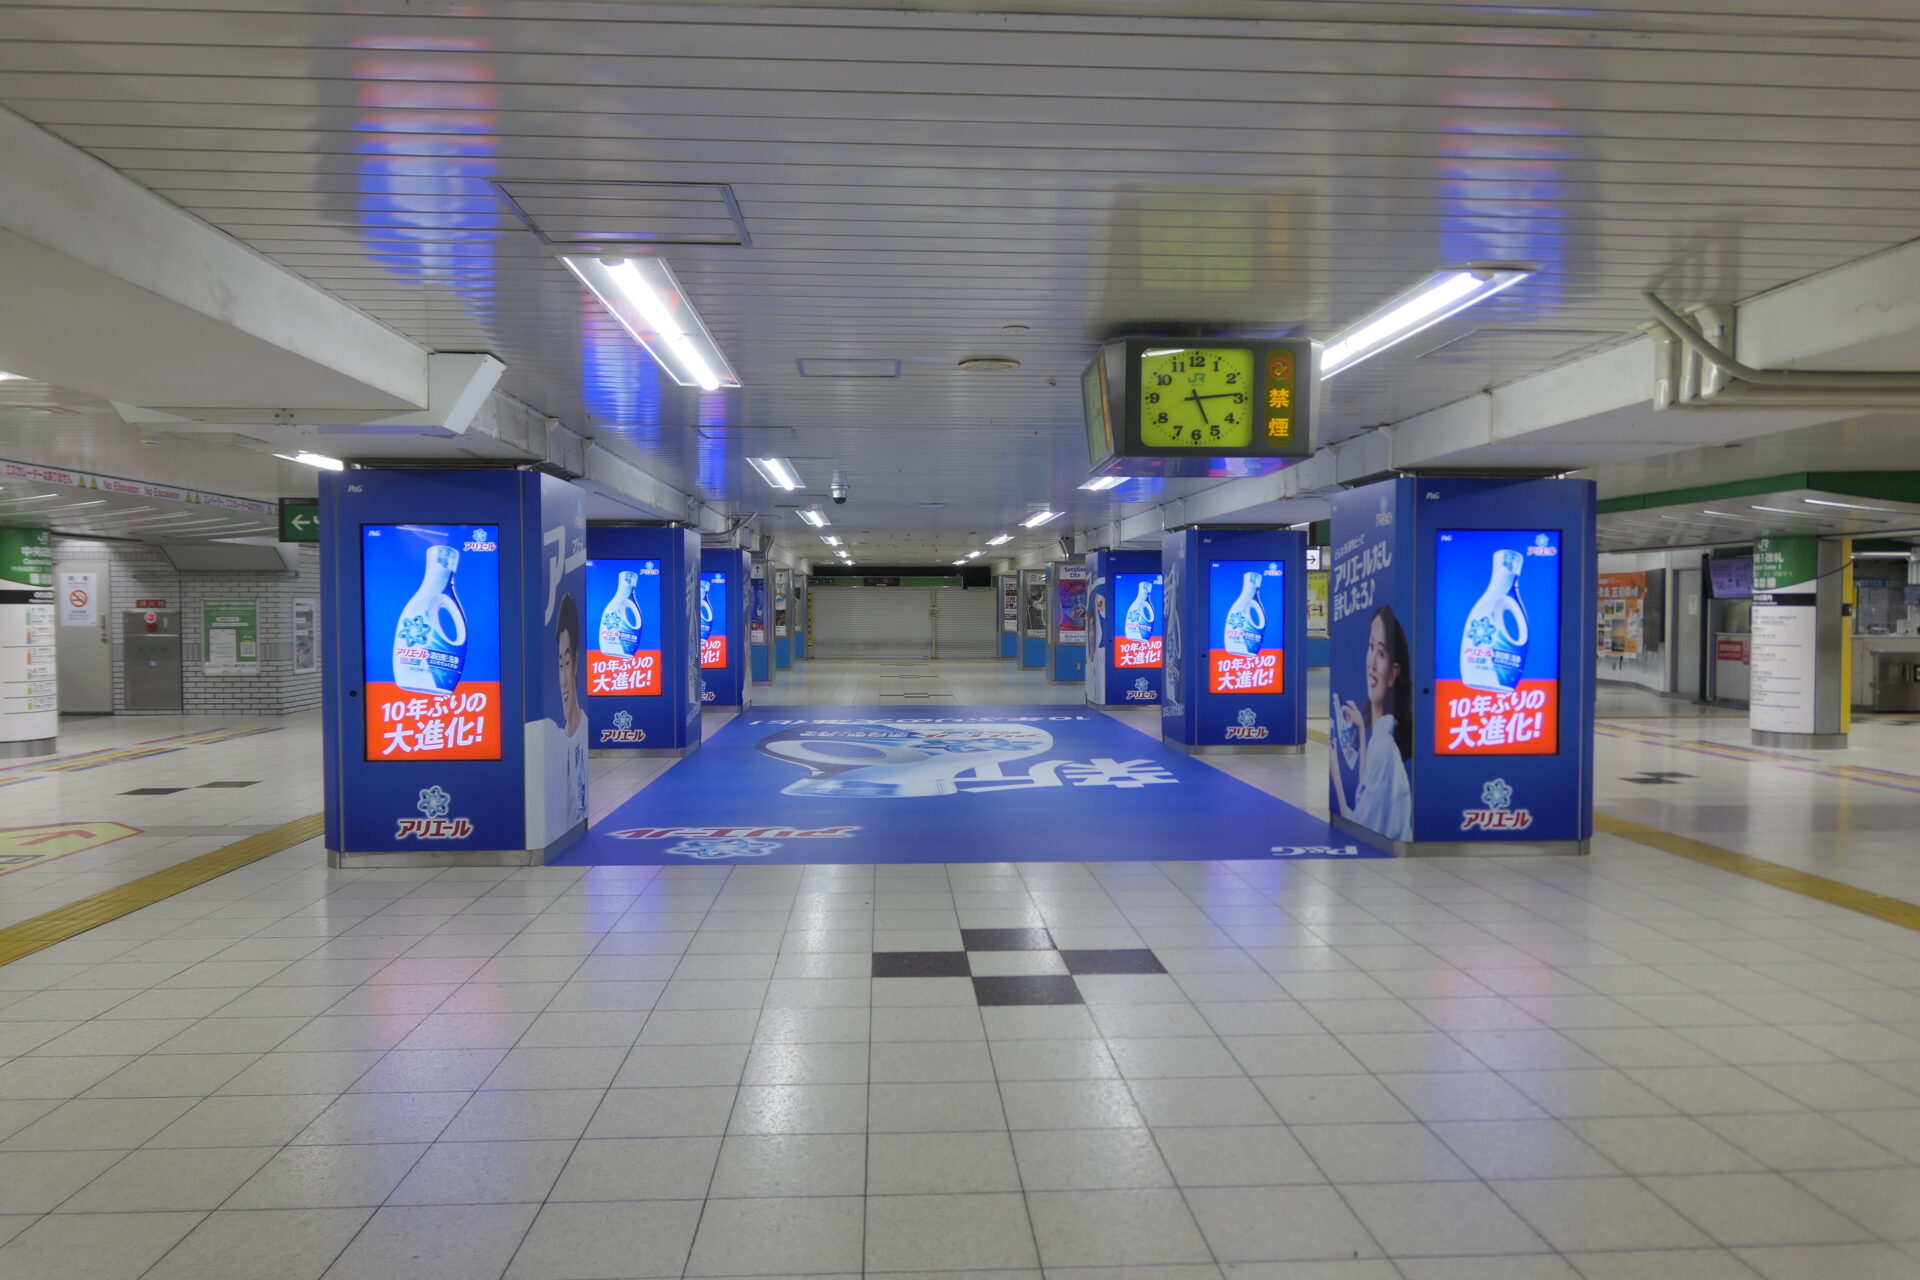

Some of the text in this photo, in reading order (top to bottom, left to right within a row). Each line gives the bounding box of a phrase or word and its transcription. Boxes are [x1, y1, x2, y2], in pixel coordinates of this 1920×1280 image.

[1172, 361, 1185, 372] 11
[1189, 356, 1205, 367] 12
[1213, 361, 1219, 371] 1
[1157, 374, 1172, 386] 10
[1188, 373, 1205, 383] JR
[1226, 373, 1237, 384] 2
[1149, 392, 1160, 404] 9
[1233, 393, 1244, 404] 3
[1157, 412, 1168, 424] 8
[1224, 413, 1235, 424] 4
[1269, 388, 1289, 437] 禁煙
[1173, 425, 1184, 437] 7
[1191, 429, 1201, 441] 6
[1210, 425, 1220, 436] 5
[103, 480, 180, 500] No Elevator No Escalator
[1426, 491, 1440, 500] P&G
[463, 542, 496, 552] アリエール
[1526, 546, 1558, 556] アリエール
[396, 648, 428, 659] アリエール
[1120, 650, 1162, 667] 大進化!
[592, 656, 654, 674] 10年ぶりの
[1217, 655, 1276, 672] 10年ぶりの
[592, 669, 652, 693] 大進化!
[1217, 668, 1275, 691] 大進化!
[1126, 691, 1157, 700] アリエール
[381, 692, 487, 722] 10年ぶりの
[1448, 689, 1546, 719] 10年ぶりの
[382, 715, 485, 756] 大進化!
[601, 729, 646, 742] アリエール
[1225, 726, 1269, 739] アリエール
[1448, 711, 1543, 750] 大進化!
[953, 758, 1180, 793] 新
[1461, 810, 1532, 830] アリエール
[396, 818, 473, 839] アリエール
[605, 826, 863, 839] アリエール
[1270, 845, 1358, 856] P&G
